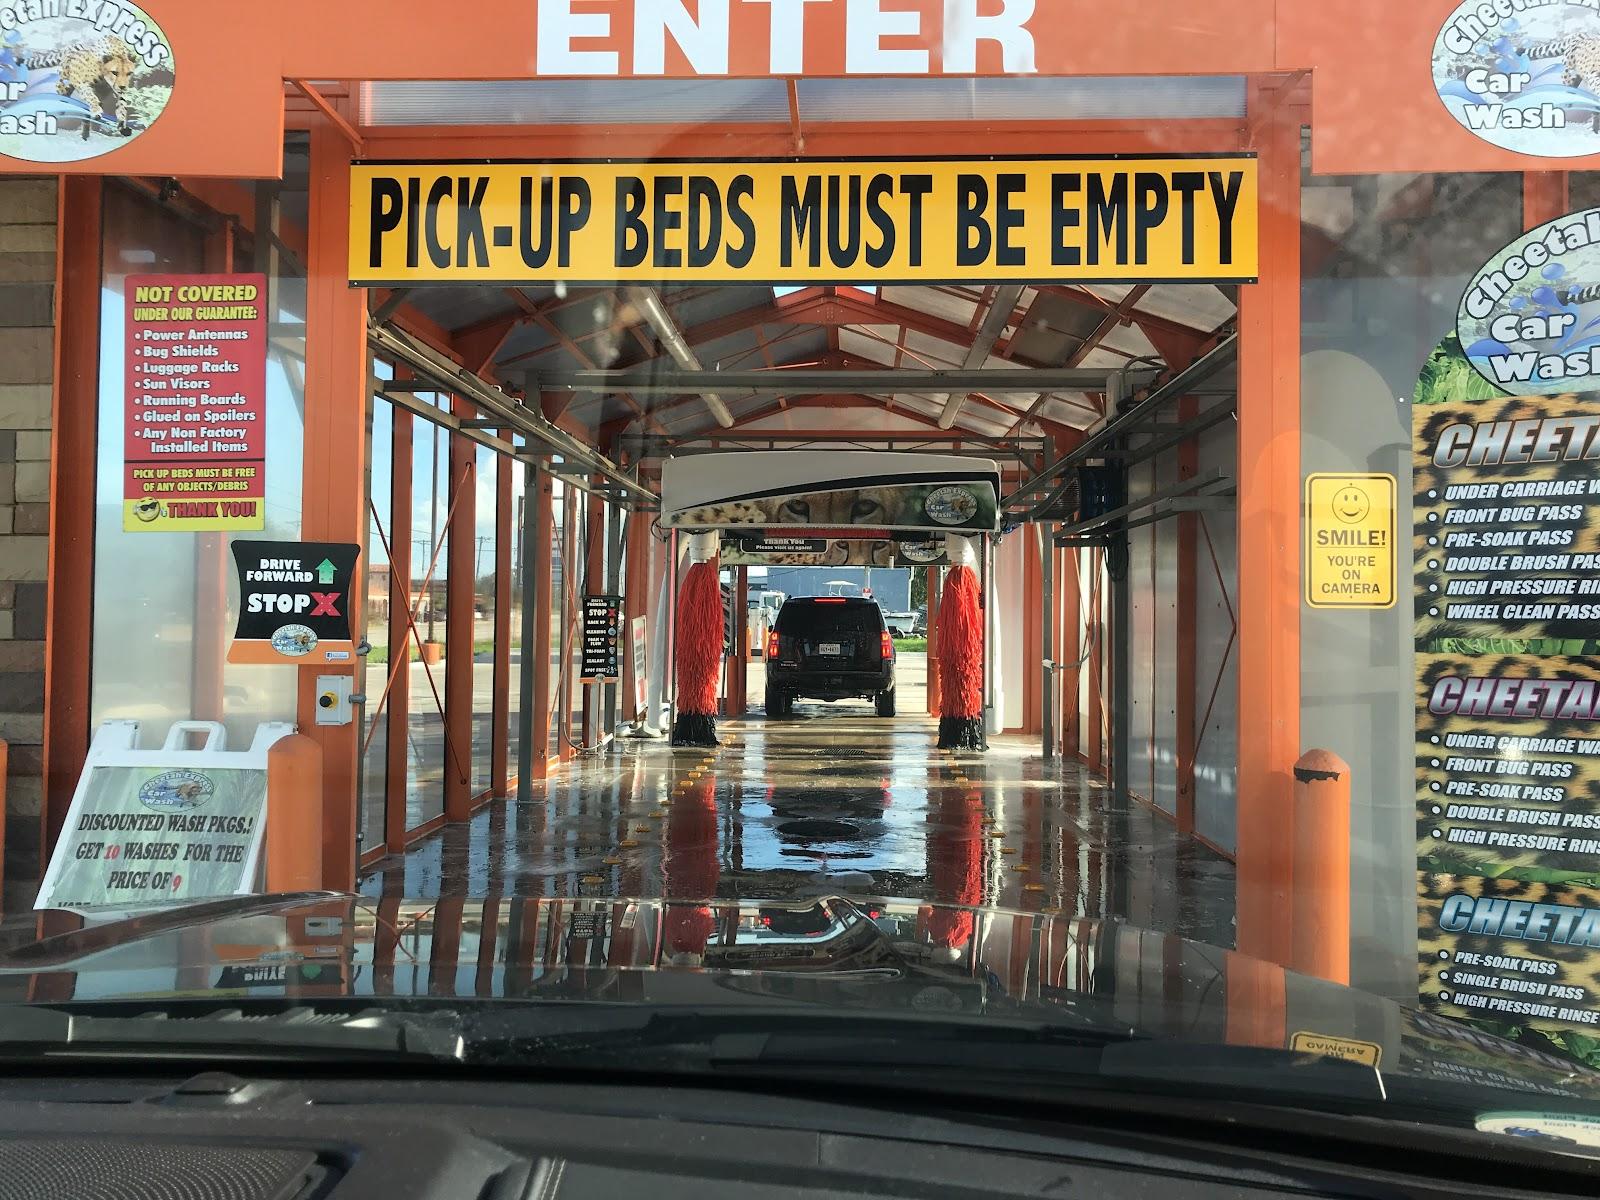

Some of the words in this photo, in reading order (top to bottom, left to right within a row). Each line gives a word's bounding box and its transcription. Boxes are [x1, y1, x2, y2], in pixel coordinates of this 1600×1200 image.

[67, 0, 169, 67] Express
[536, 0, 1038, 75] ENTER
[1465, 68, 1531, 94] Car
[0, 111, 57, 134] ash
[1463, 103, 1565, 129] Wash
[369, 176, 591, 269] PICK-UP
[614, 174, 756, 269] BEDS
[780, 173, 932, 269] MUST
[956, 173, 1026, 267] BE
[1050, 171, 1244, 266] EMPTY
[135, 287, 173, 302] NOT
[177, 286, 257, 301] COVERED
[134, 308, 168, 321] UNDER
[171, 307, 193, 320] OUR
[196, 306, 257, 320] GUARANTEE:
[143, 330, 184, 340] Power
[188, 329, 248, 340] Antennas
[1491, 312, 1576, 343] Car
[143, 346, 168, 358] Bug
[172, 345, 218, 356] Shields
[143, 362, 198, 375] Luggage
[202, 361, 239, 373] Racks
[143, 378, 167, 389] Sun
[170, 377, 210, 389] Visors
[143, 394, 196, 407] Running
[200, 393, 246, 405] Boards
[143, 410, 180, 422] Glued
[184, 412, 200, 421] on
[204, 409, 256, 423] Spoilers
[142, 427, 167, 440] Any
[171, 427, 196, 438] Non
[200, 426, 246, 439] Factory
[151, 441, 208, 453] Installed
[212, 441, 248, 452] Items
[133, 469, 153, 479] PICK
[156, 469, 169, 478] UP
[171, 469, 193, 478] BEDS
[195, 468, 220, 478] MUST
[222, 468, 233, 477] BE
[235, 467, 255, 477] FREE
[143, 482, 155, 491] OF
[156, 482, 175, 491] ANY
[177, 481, 248, 491] OBJECTS/DEBRIS
[1445, 484, 1499, 500] UNDER
[1501, 479, 1587, 498] CARRIAGE
[167, 502, 219, 518] THANK
[221, 501, 257, 517] YOU!
[1445, 508, 1498, 524] FRONT
[1499, 507, 1535, 522] BUG
[1537, 505, 1583, 521] PASS
[1316, 529, 1386, 546] SMILE!
[1445, 531, 1527, 548] PRE-SOAK
[1528, 529, 1573, 545] PASS
[260, 559, 301, 570] DRIVE
[1327, 555, 1376, 567] YOU'RE
[1445, 556, 1509, 571] DOUBLE
[1510, 554, 1570, 570] BRUSH
[246, 571, 314, 583] FORWARD
[1342, 569, 1360, 580] ON
[1321, 583, 1381, 594] CAMERA
[1447, 580, 1488, 595] HIGH
[1489, 579, 1575, 595] PRESSURE
[247, 593, 311, 613] STOP
[1447, 604, 1500, 619] WHEEL
[1502, 604, 1557, 620] CLEAN
[1428, 675, 1600, 720] CHEETA
[1445, 734, 1496, 749] UNDER
[1497, 736, 1575, 754] CARRIAGE
[1445, 757, 1495, 773] FRONT
[1496, 760, 1529, 775] BUG
[1530, 762, 1573, 778] PASS
[1445, 781, 1522, 799] PRE-SOAK
[1522, 786, 1564, 802] PASS
[77, 814, 165, 831] DISCOUNTED
[167, 815, 207, 833] WASH
[1446, 805, 1505, 822] DOUBLE
[1506, 808, 1561, 826] BRUSH
[1448, 829, 1487, 845] HIGH
[1488, 832, 1568, 851] PRESSURE
[76, 842, 104, 860] GET
[104, 845, 120, 860] 10
[123, 842, 180, 861] WASHES
[182, 844, 213, 862] FOR
[215, 845, 245, 863] THE
[107, 871, 150, 889] PRICE
[152, 872, 173, 890] OF
[172, 875, 182, 892] 9
[1439, 894, 1600, 948] CHEETA
[1454, 952, 1520, 972] PRE-SOAK
[1521, 960, 1557, 976] PASS
[1453, 972, 1499, 989] SINGLE
[1499, 978, 1548, 996] BRUSH
[1548, 985, 1584, 1001] PASS
[1454, 993, 1488, 1008] HIGH
[1488, 998, 1557, 1019] PRESSURE
[1557, 1007, 1599, 1024] RINSE
